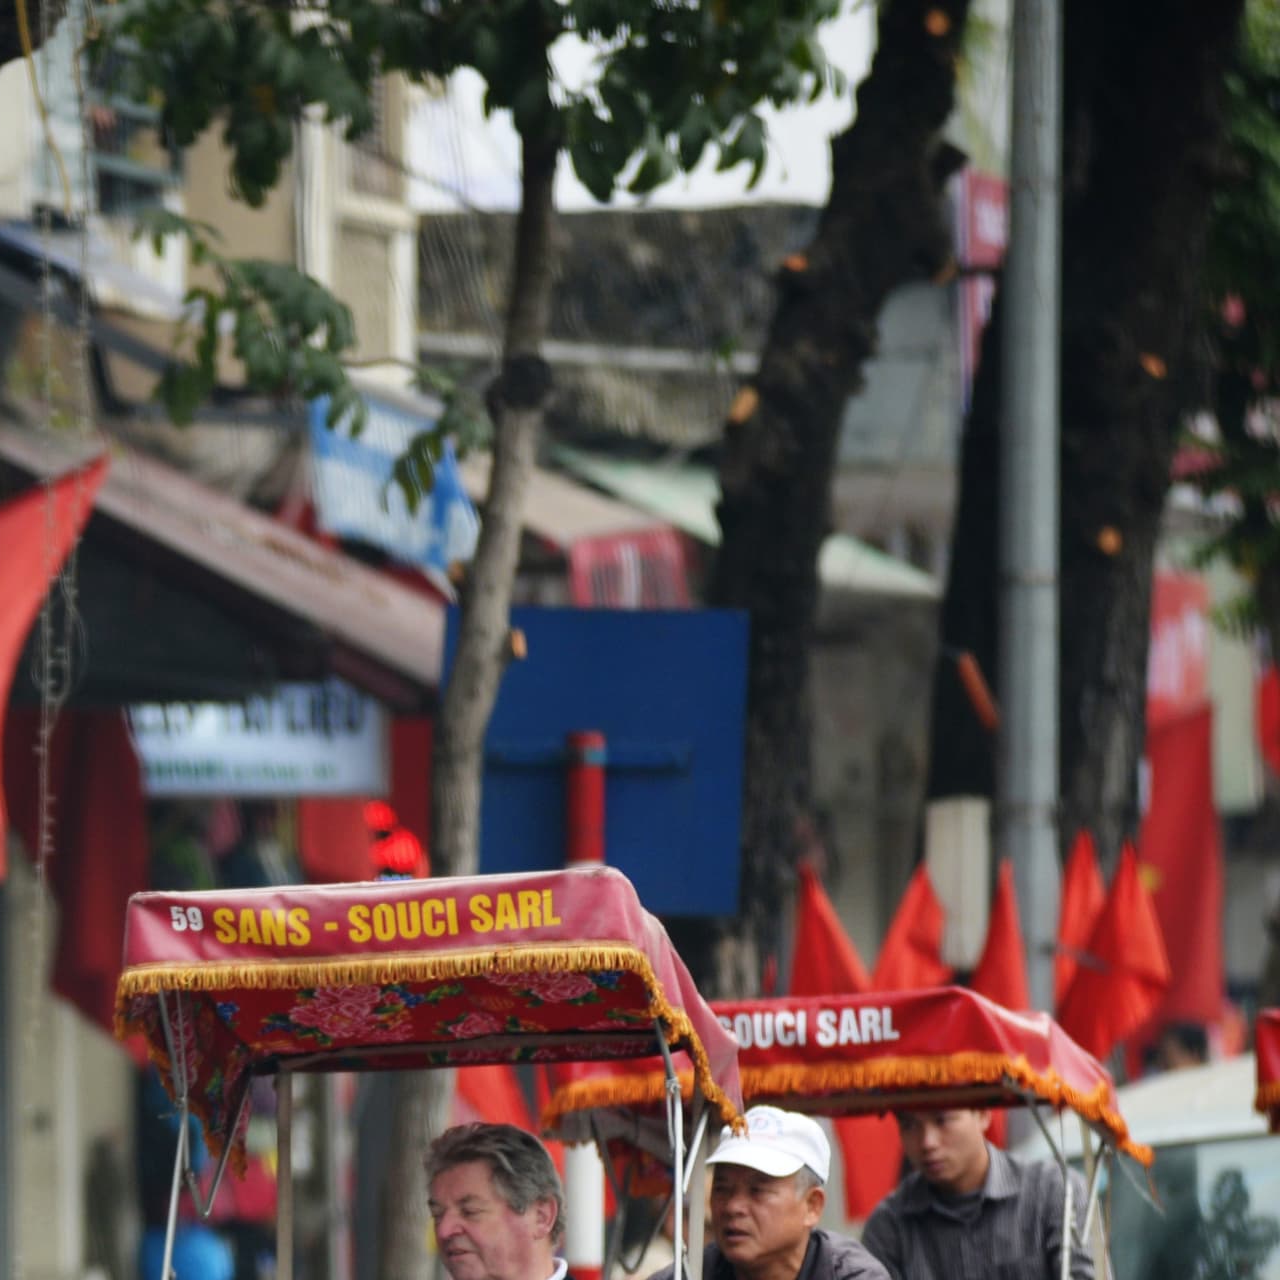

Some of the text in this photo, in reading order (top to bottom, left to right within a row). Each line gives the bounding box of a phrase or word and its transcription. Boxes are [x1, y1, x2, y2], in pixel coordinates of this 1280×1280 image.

[170, 905, 203, 932] 59
[213, 907, 311, 946] SANS
[348, 898, 459, 943] SOUCI
[468, 888, 561, 933] SARL
[815, 1002, 900, 1048] SARL
